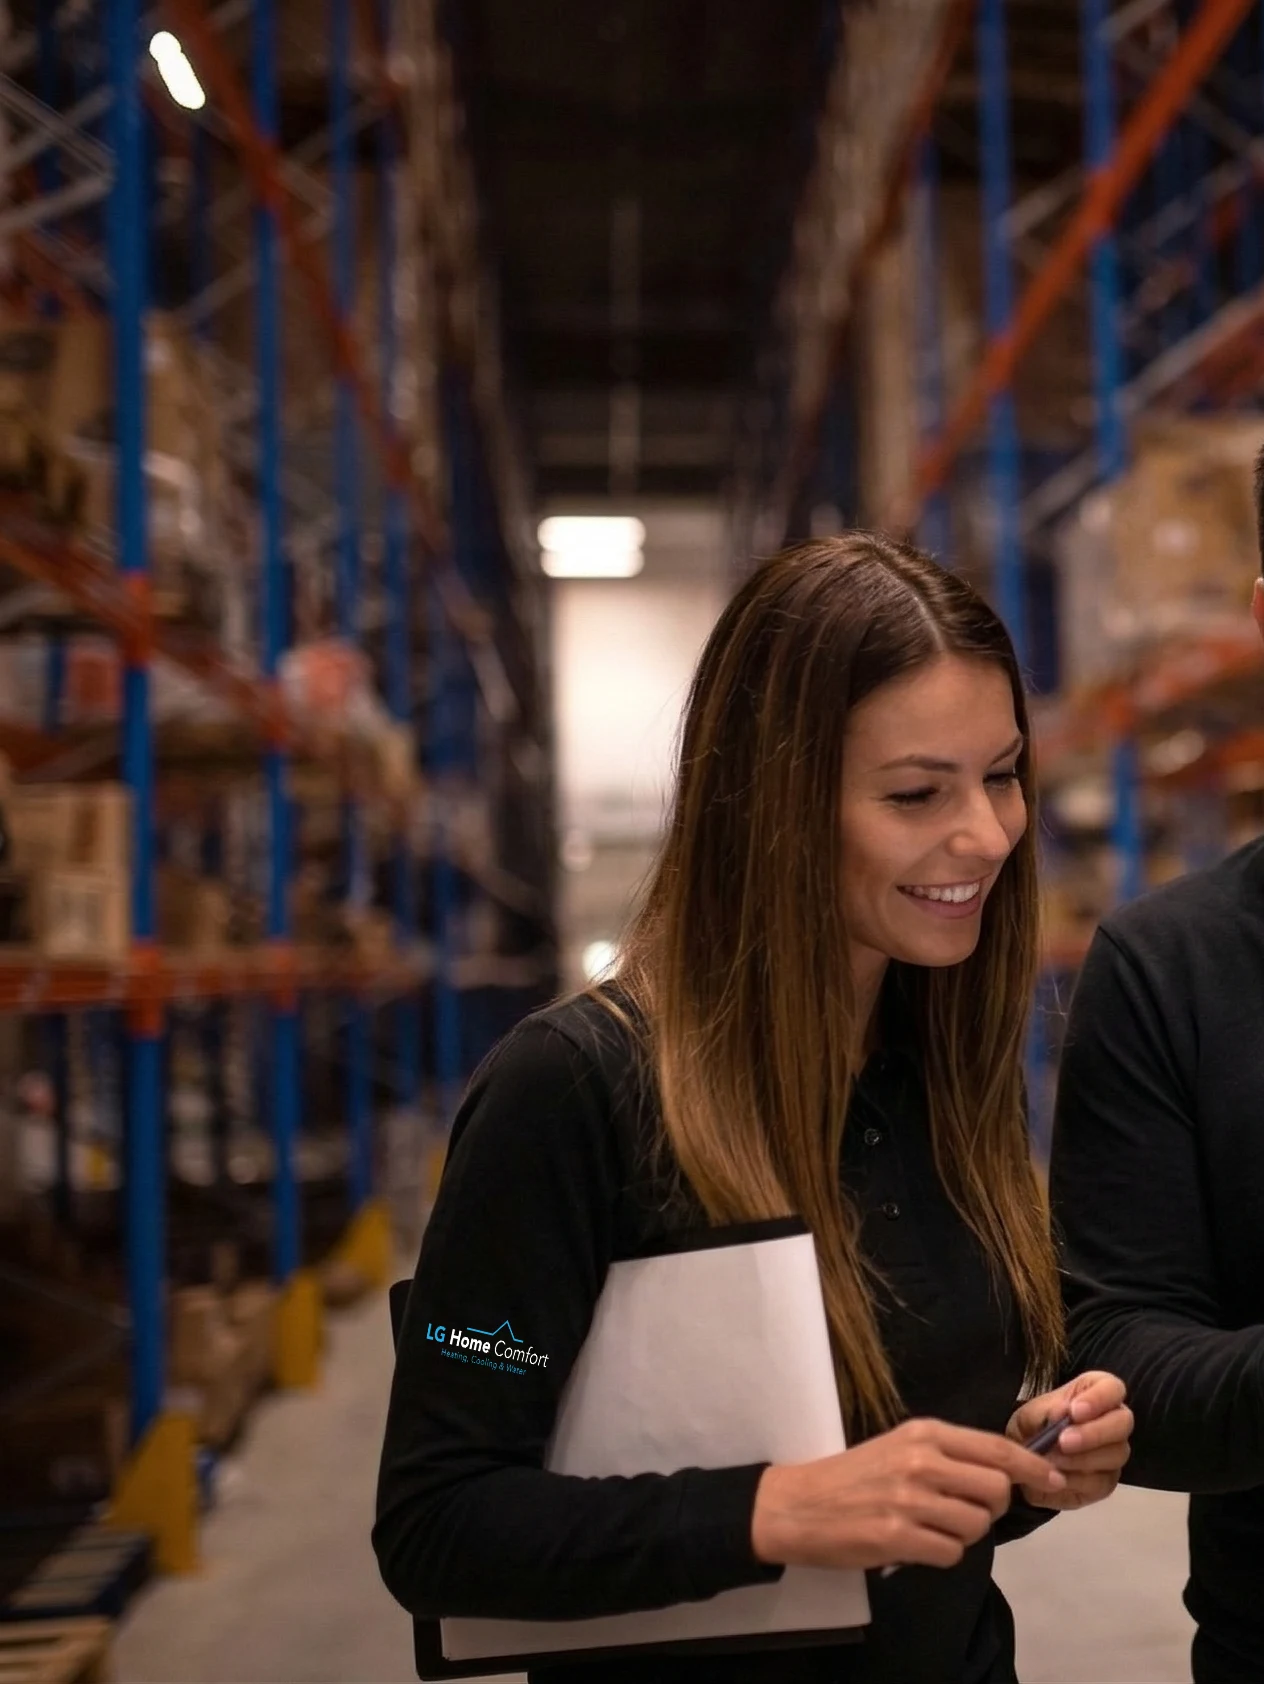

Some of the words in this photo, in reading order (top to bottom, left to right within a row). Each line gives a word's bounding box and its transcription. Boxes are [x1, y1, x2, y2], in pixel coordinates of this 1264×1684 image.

[426, 1323, 446, 1342] LG
[449, 1329, 491, 1353] Home
[494, 1340, 549, 1368] Comfort
[440, 1348, 469, 1363] Heating,
[471, 1355, 497, 1370] Cooling
[498, 1362, 505, 1371] &
[506, 1363, 527, 1376] Water
